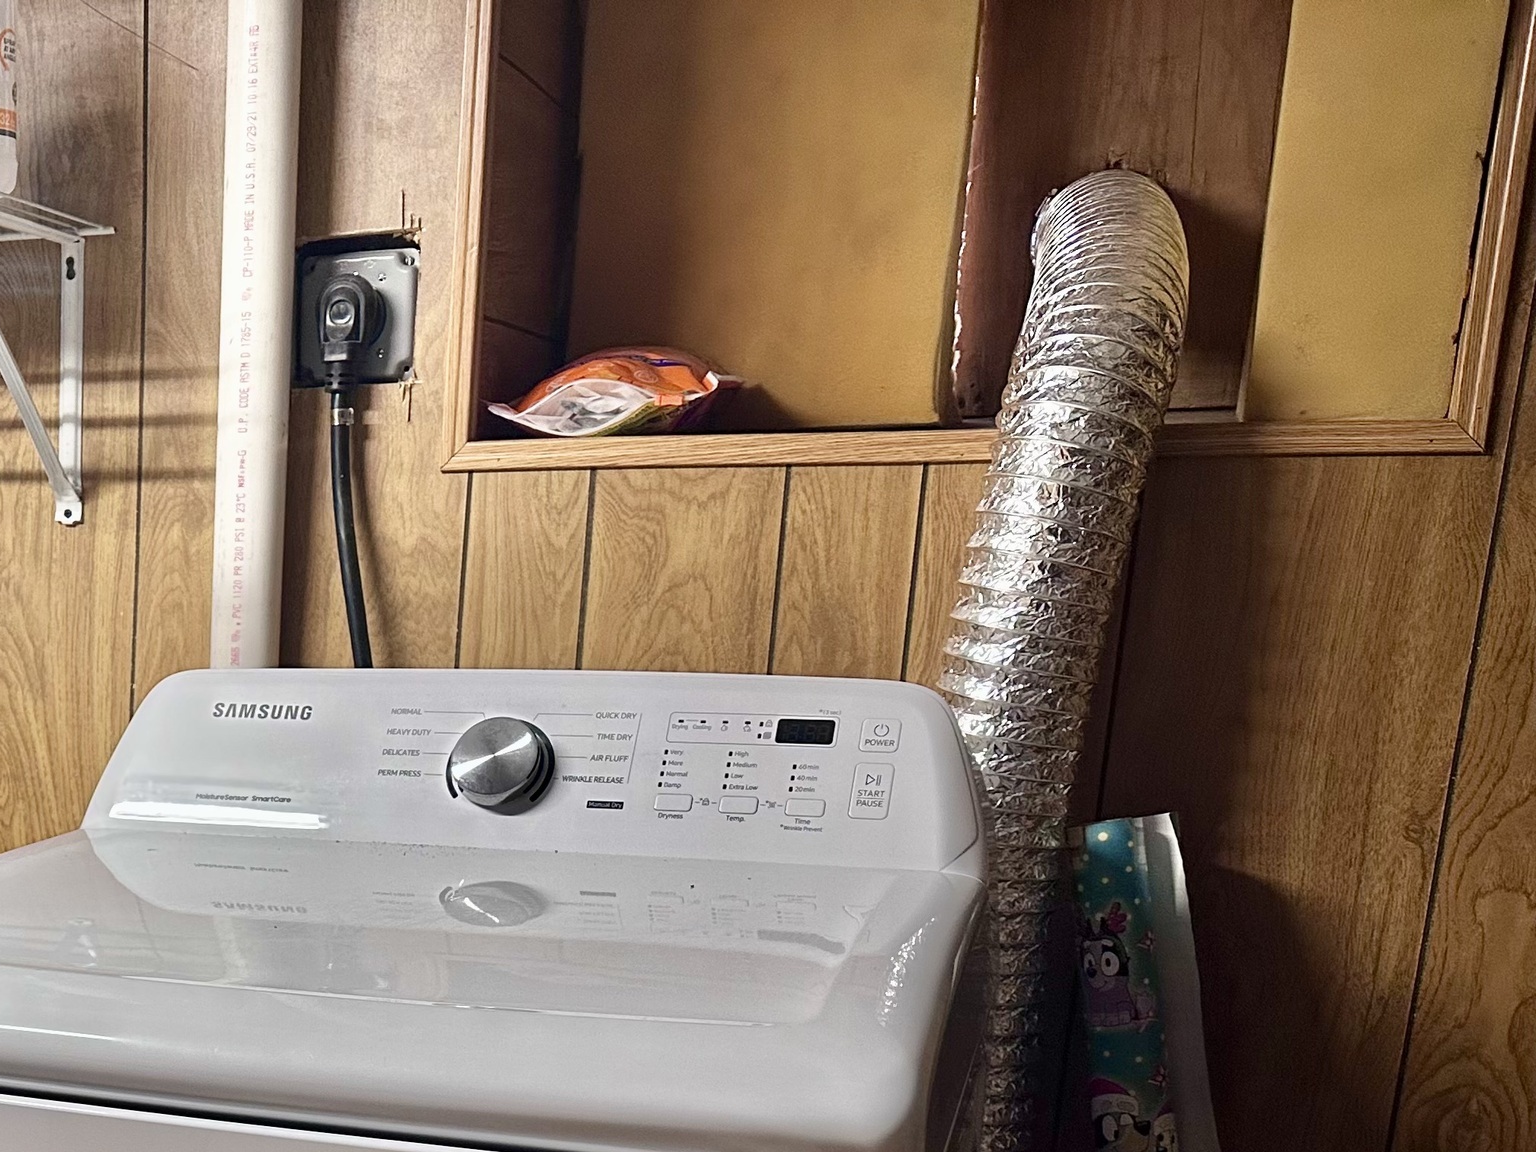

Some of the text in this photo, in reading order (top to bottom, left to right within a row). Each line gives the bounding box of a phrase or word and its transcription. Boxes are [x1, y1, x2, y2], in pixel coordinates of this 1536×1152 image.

[0, 112, 11, 126] 32
[246, 111, 258, 152] 07/29/21
[244, 158, 256, 190] U.S.A.
[244, 194, 255, 204] IN
[244, 210, 254, 230] MADE
[240, 362, 251, 383] ASTM
[239, 388, 250, 408] CODE
[234, 546, 244, 562] 280
[233, 566, 243, 576] PR
[232, 580, 242, 599] 1120
[232, 604, 242, 619] PVC
[212, 702, 313, 720] SAMSUNG
[596, 712, 620, 720] QUICK
[620, 712, 638, 720] DRY
[386, 728, 412, 736] HEAVY
[597, 732, 616, 740] TIME
[864, 739, 896, 747] POWER
[382, 748, 420, 757] DELICATES
[590, 754, 604, 762] AIR
[398, 770, 422, 778] PRESS
[594, 776, 624, 784] RELEASE
[252, 795, 292, 803] SmartCare
[857, 790, 886, 798] START
[856, 800, 884, 808] PAUSE
[658, 812, 684, 820] Dryness
